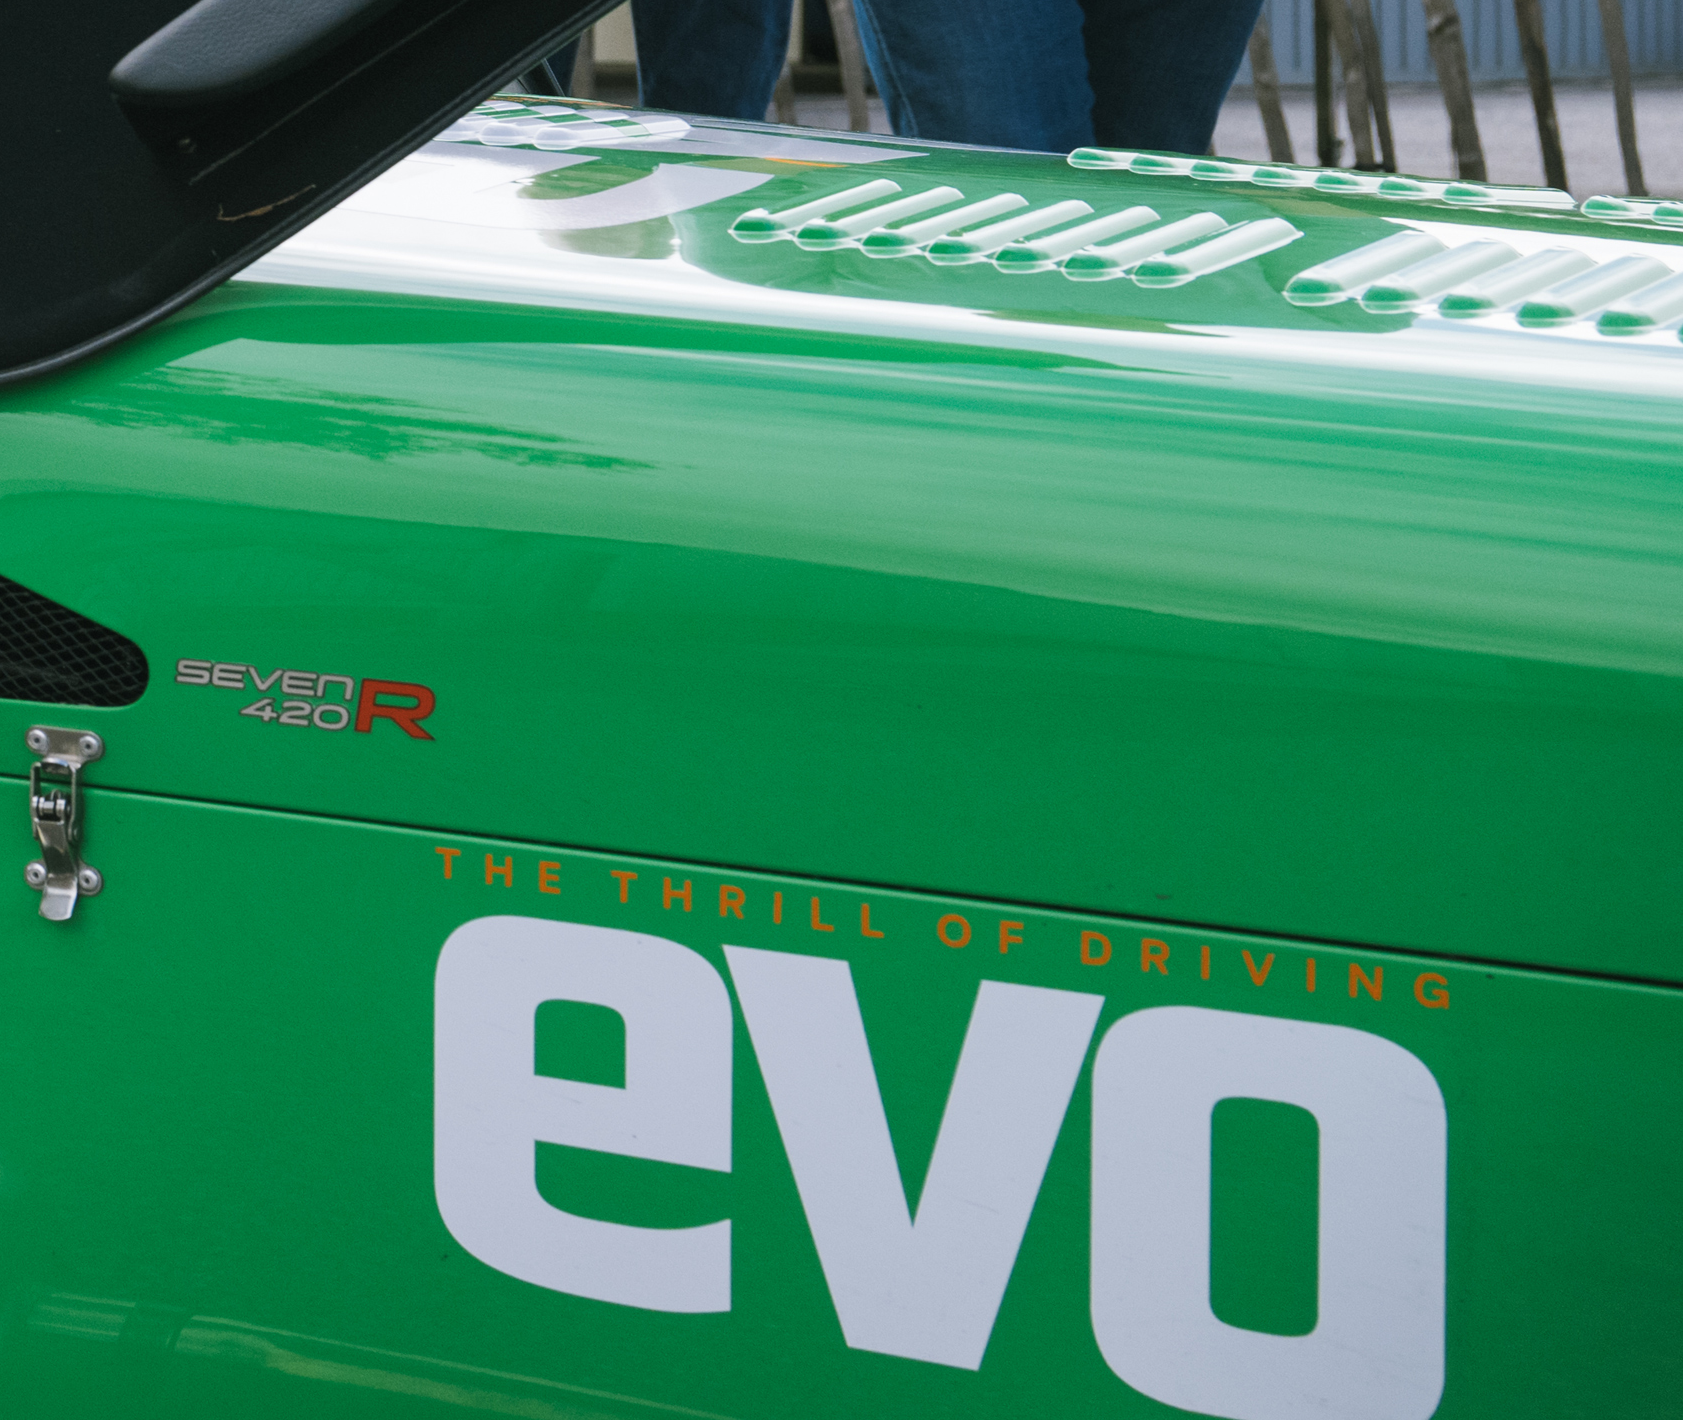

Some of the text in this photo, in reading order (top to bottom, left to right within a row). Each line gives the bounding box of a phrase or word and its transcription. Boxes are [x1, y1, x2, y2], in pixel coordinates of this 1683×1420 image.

[434, 846, 1450, 1010] THE THRILL OF DRIVING
[434, 915, 1447, 1420] evo
